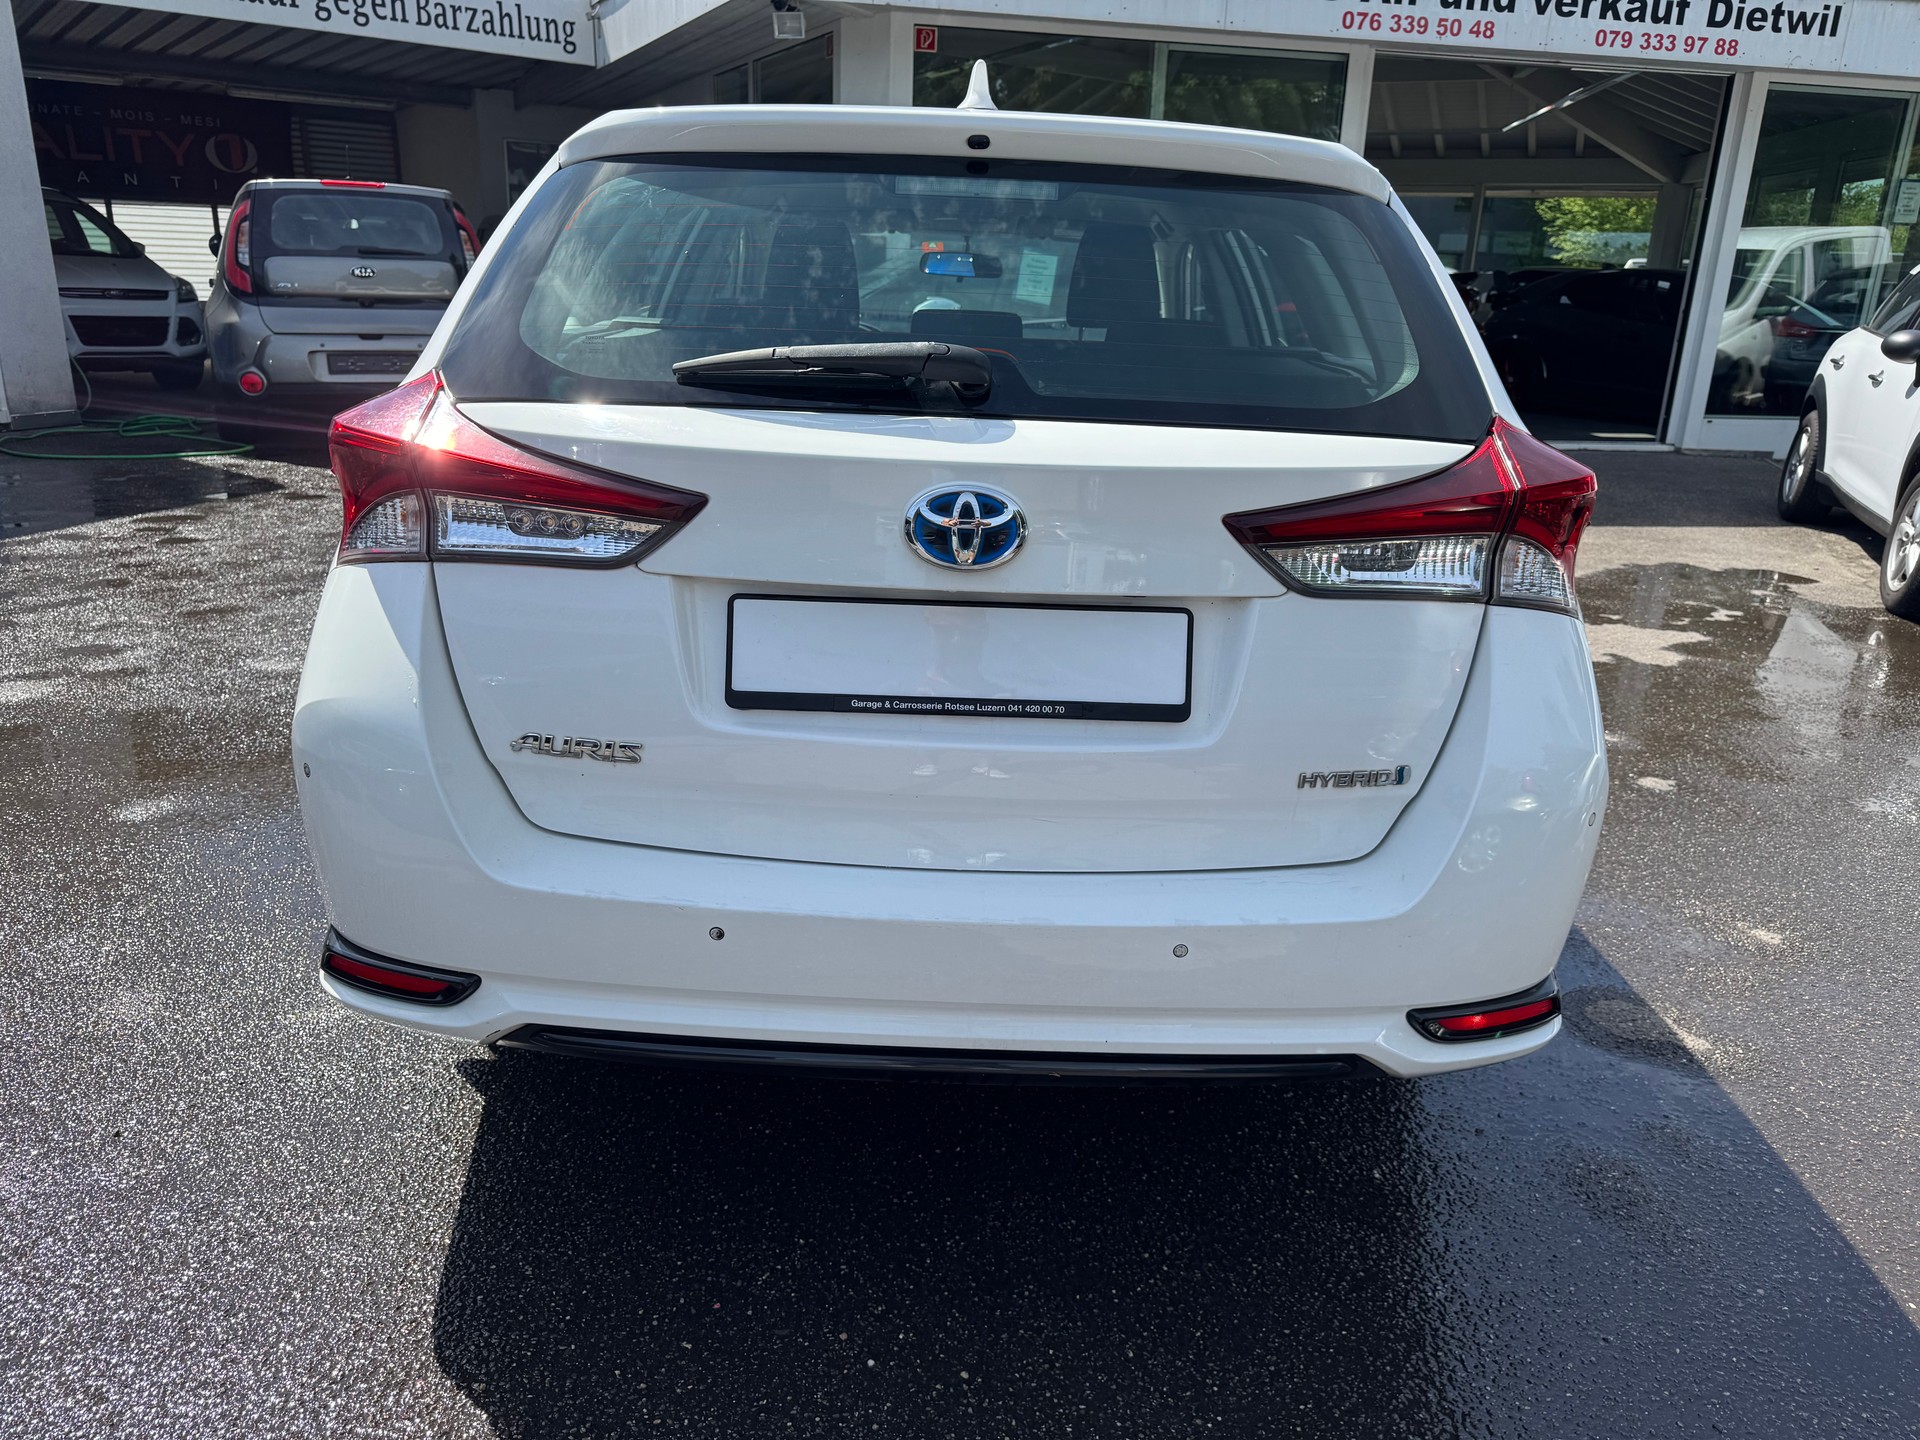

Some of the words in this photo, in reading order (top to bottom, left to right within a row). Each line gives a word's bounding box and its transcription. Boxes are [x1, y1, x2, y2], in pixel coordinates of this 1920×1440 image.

[314, 0, 410, 27] gegen
[416, 0, 577, 54] Barzahlung
[1342, 11, 1382, 31] 076
[1389, 14, 1429, 35] 339
[1436, 18, 1462, 37] 50
[1469, 20, 1495, 39] 48
[1706, 0, 1843, 37] Dietwil
[1595, 29, 1633, 49] 079
[1639, 32, 1677, 52] 333
[1683, 36, 1709, 54] 97
[1714, 38, 1739, 57] 88
[29, 103, 84, 116] NATE
[110, 109, 154, 122] MOIS
[180, 115, 221, 128] MESI
[352, 267, 375, 278] KIA
[851, 700, 883, 710] Garage
[884, 700, 891, 708] &
[893, 701, 943, 710] Carrosserie
[945, 702, 975, 711] Rotsee
[977, 703, 1006, 712] Luzern
[1008, 704, 1022, 712] 041
[1025, 704, 1041, 713] 420
[1042, 705, 1053, 713] 00
[1055, 705, 1065, 714] 70
[509, 732, 643, 764] AURIS
[1297, 769, 1395, 788] HYBRID
